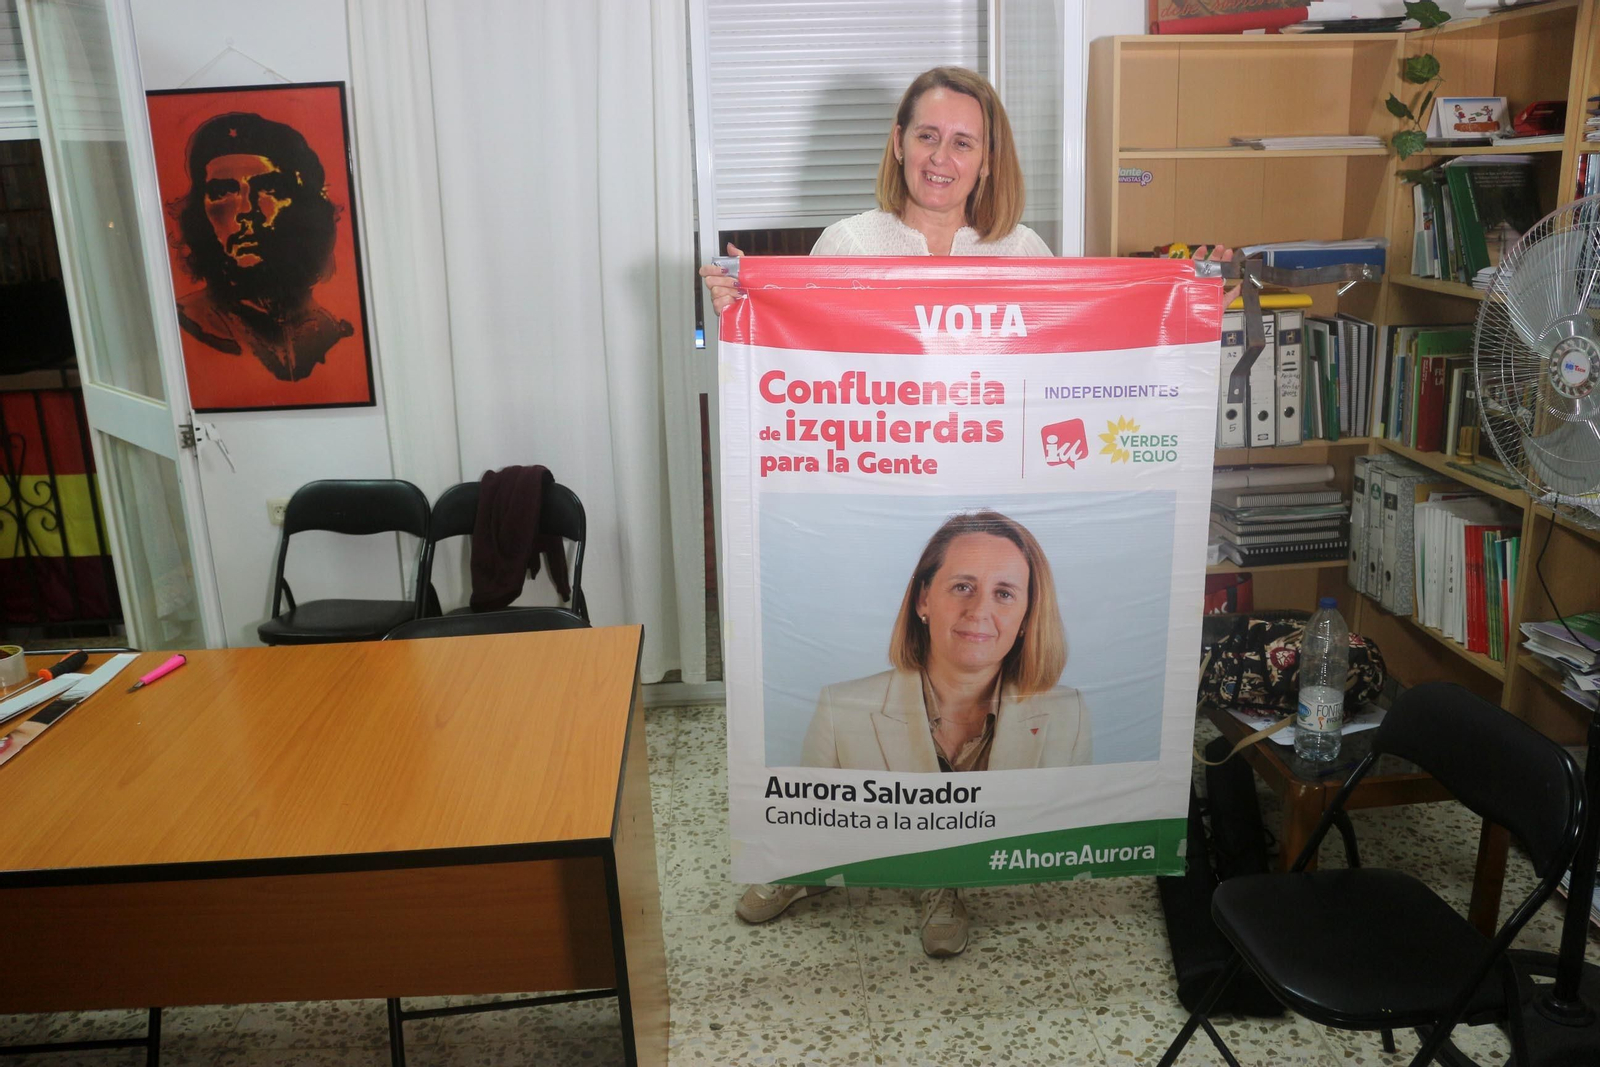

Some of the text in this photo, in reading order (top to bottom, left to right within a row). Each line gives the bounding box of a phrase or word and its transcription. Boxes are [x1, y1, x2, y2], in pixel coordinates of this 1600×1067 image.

[914, 304, 1028, 338] VOTA
[759, 370, 1005, 405] Confluencia
[1045, 385, 1179, 399] INDEPENDIENTES
[759, 409, 1004, 450] de izquierdas
[1120, 435, 1178, 447] VERDES
[760, 449, 937, 477] para la Gente
[1133, 450, 1177, 462] EQUO
[765, 776, 981, 804] Aurora Salvador
[765, 806, 996, 830] Candidata a la alcaldía
[989, 844, 1155, 870] #AhoraAurora
